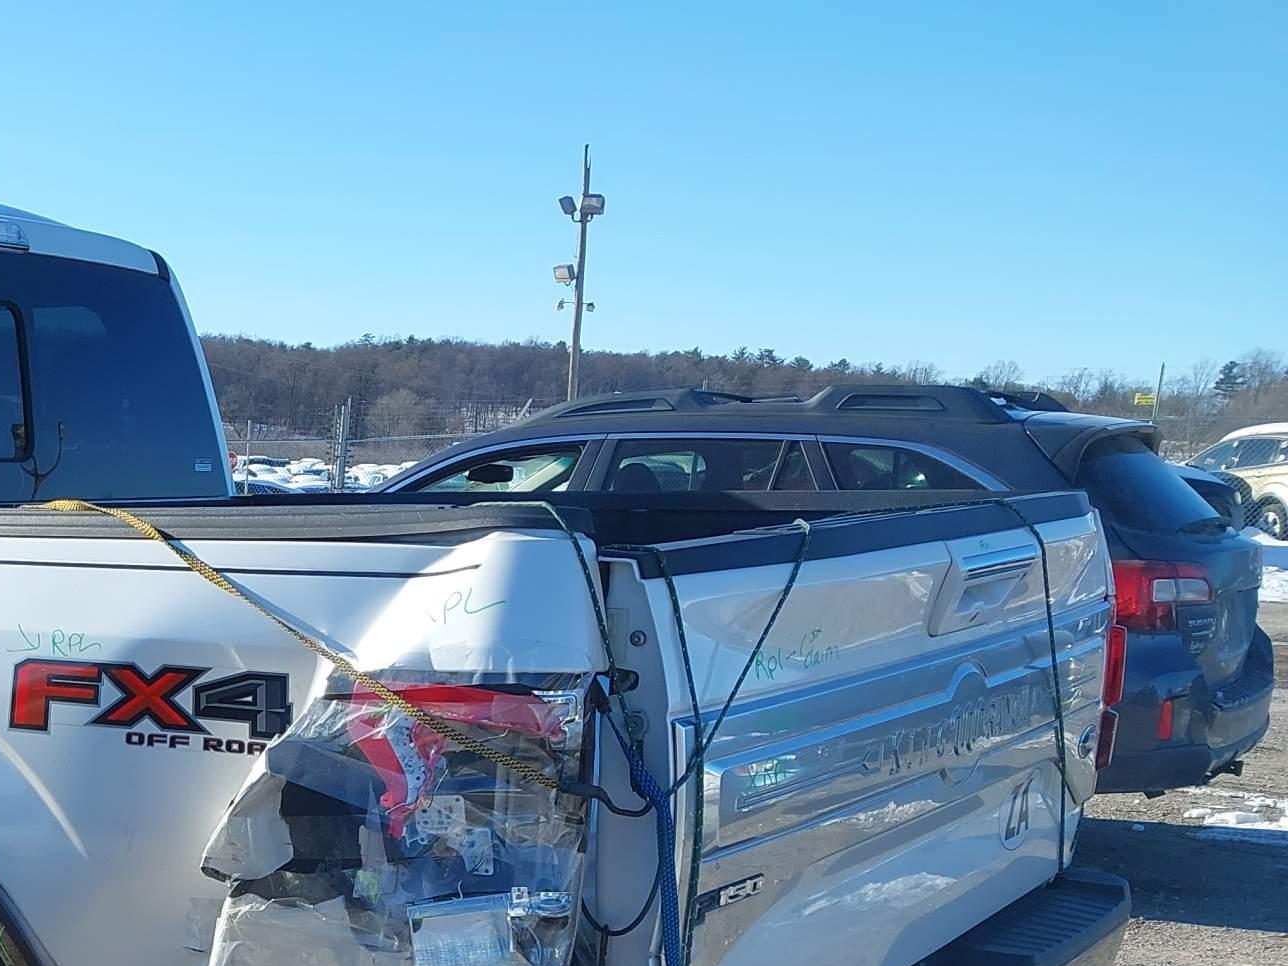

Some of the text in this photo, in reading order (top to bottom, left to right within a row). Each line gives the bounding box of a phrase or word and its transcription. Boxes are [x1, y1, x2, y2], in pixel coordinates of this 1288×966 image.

[8, 658, 294, 742] FX4
[125, 731, 270, 757] OFF ROA
